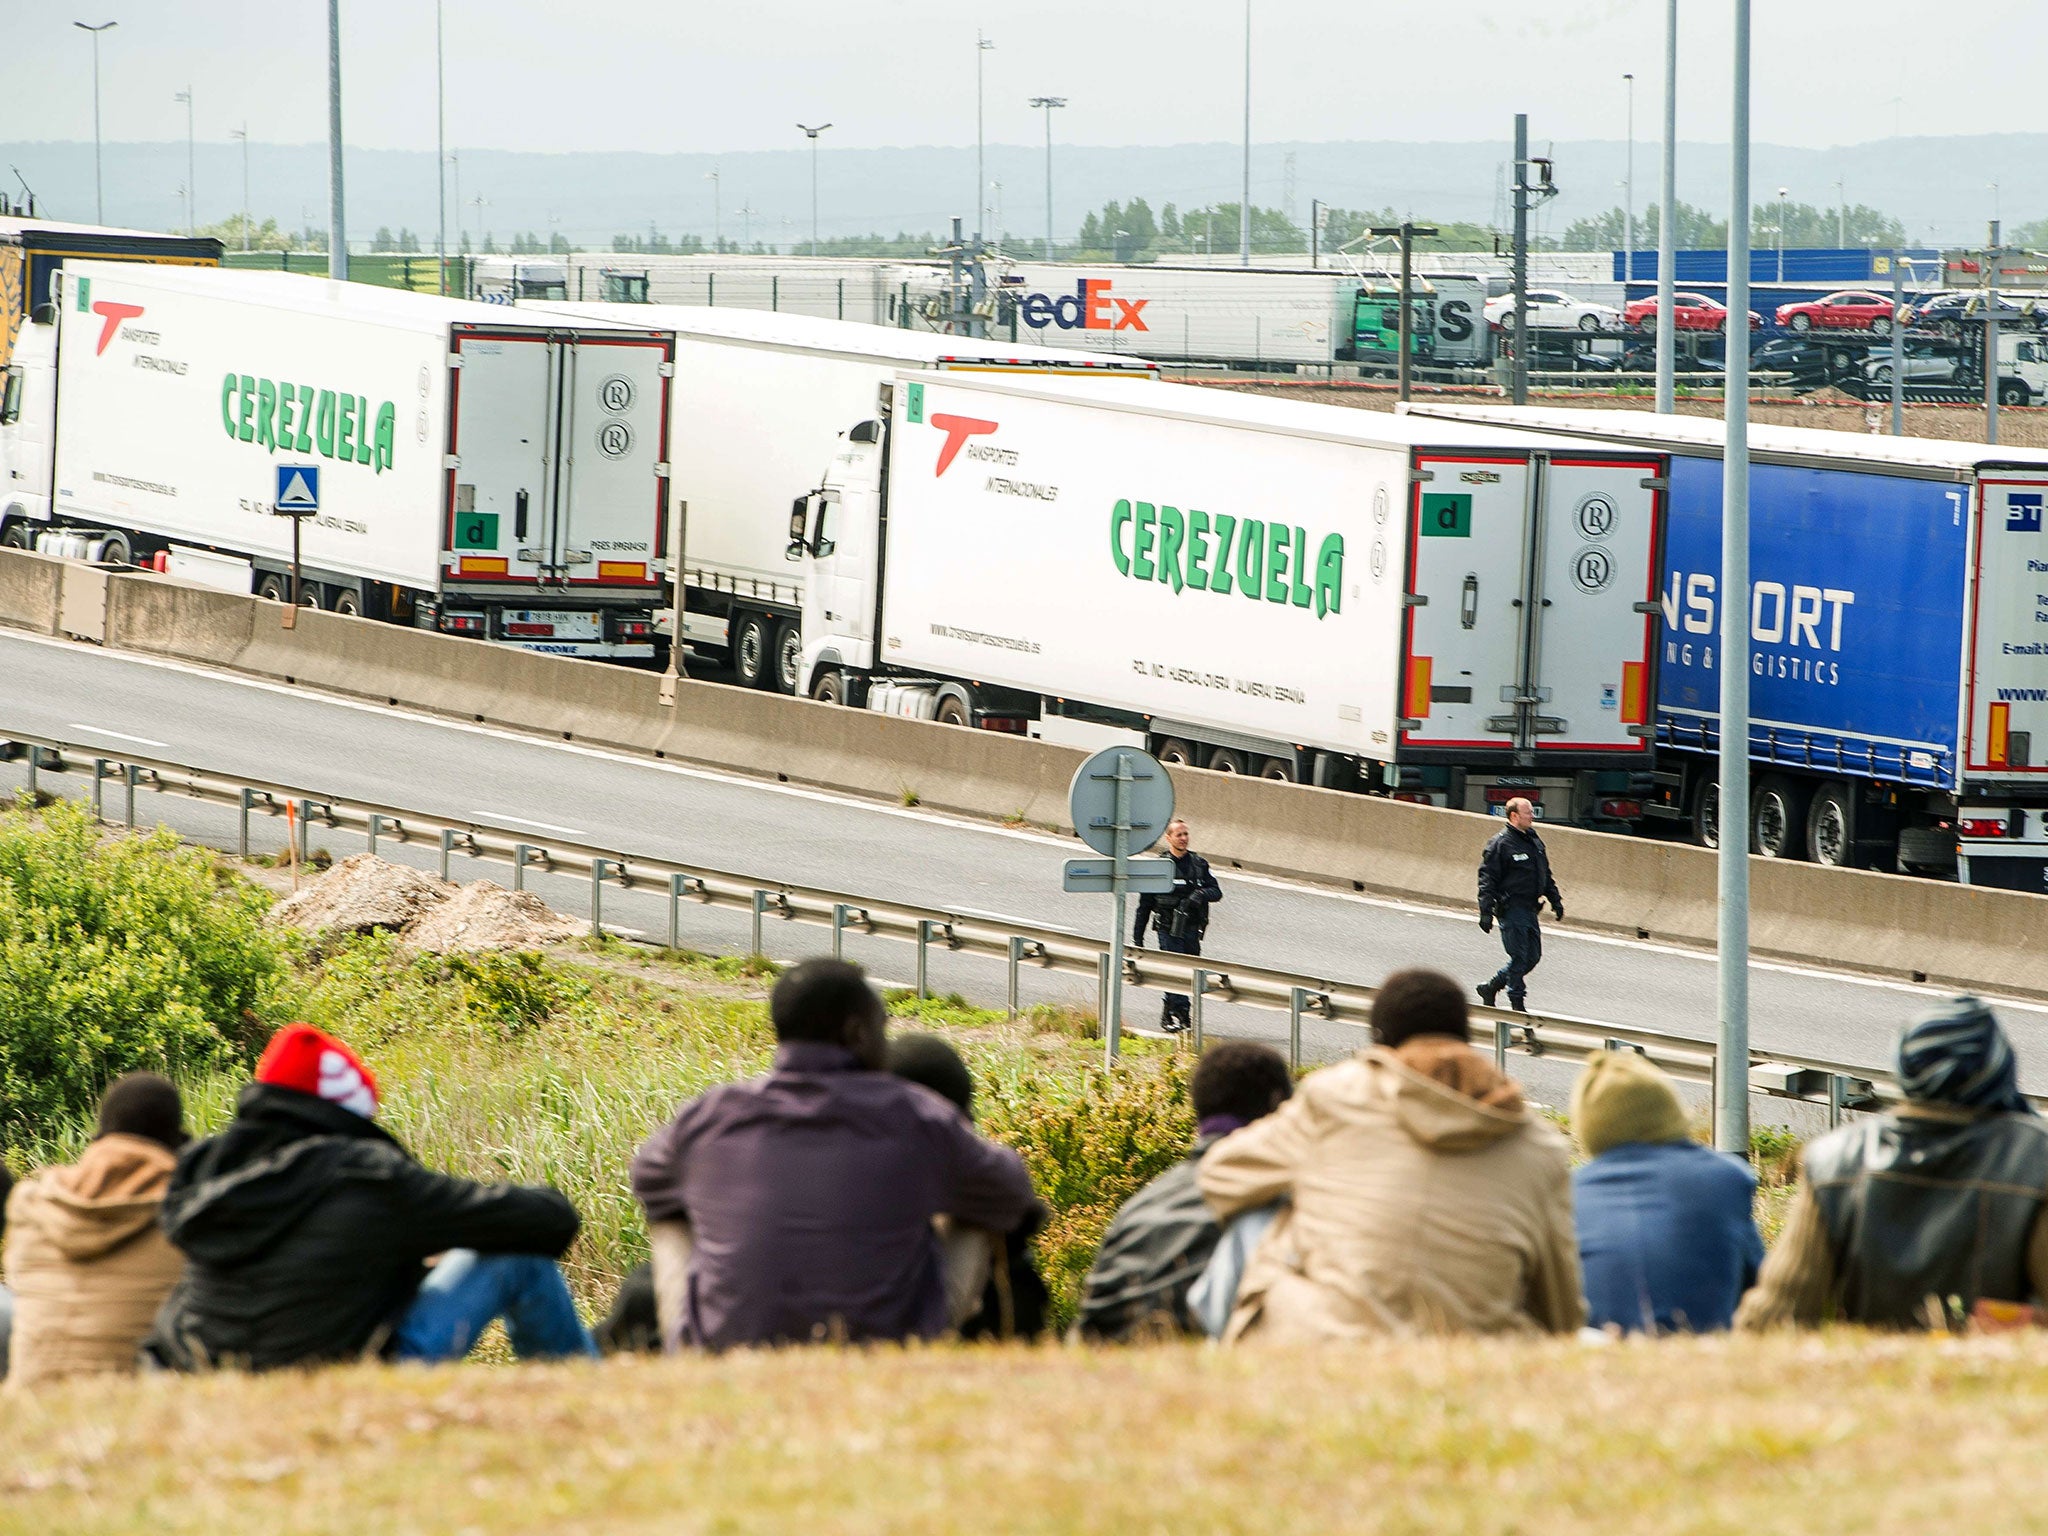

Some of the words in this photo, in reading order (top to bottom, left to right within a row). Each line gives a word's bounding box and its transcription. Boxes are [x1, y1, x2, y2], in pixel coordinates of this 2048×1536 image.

[222, 373, 396, 475] CEREZUELA
[466, 520, 485, 544] d
[1437, 501, 1458, 529] d
[1111, 499, 1345, 621] CEREZUELA
[1661, 571, 1855, 652] NSORT
[1666, 641, 1693, 667] NG
[1752, 652, 1840, 686] GISTICS
